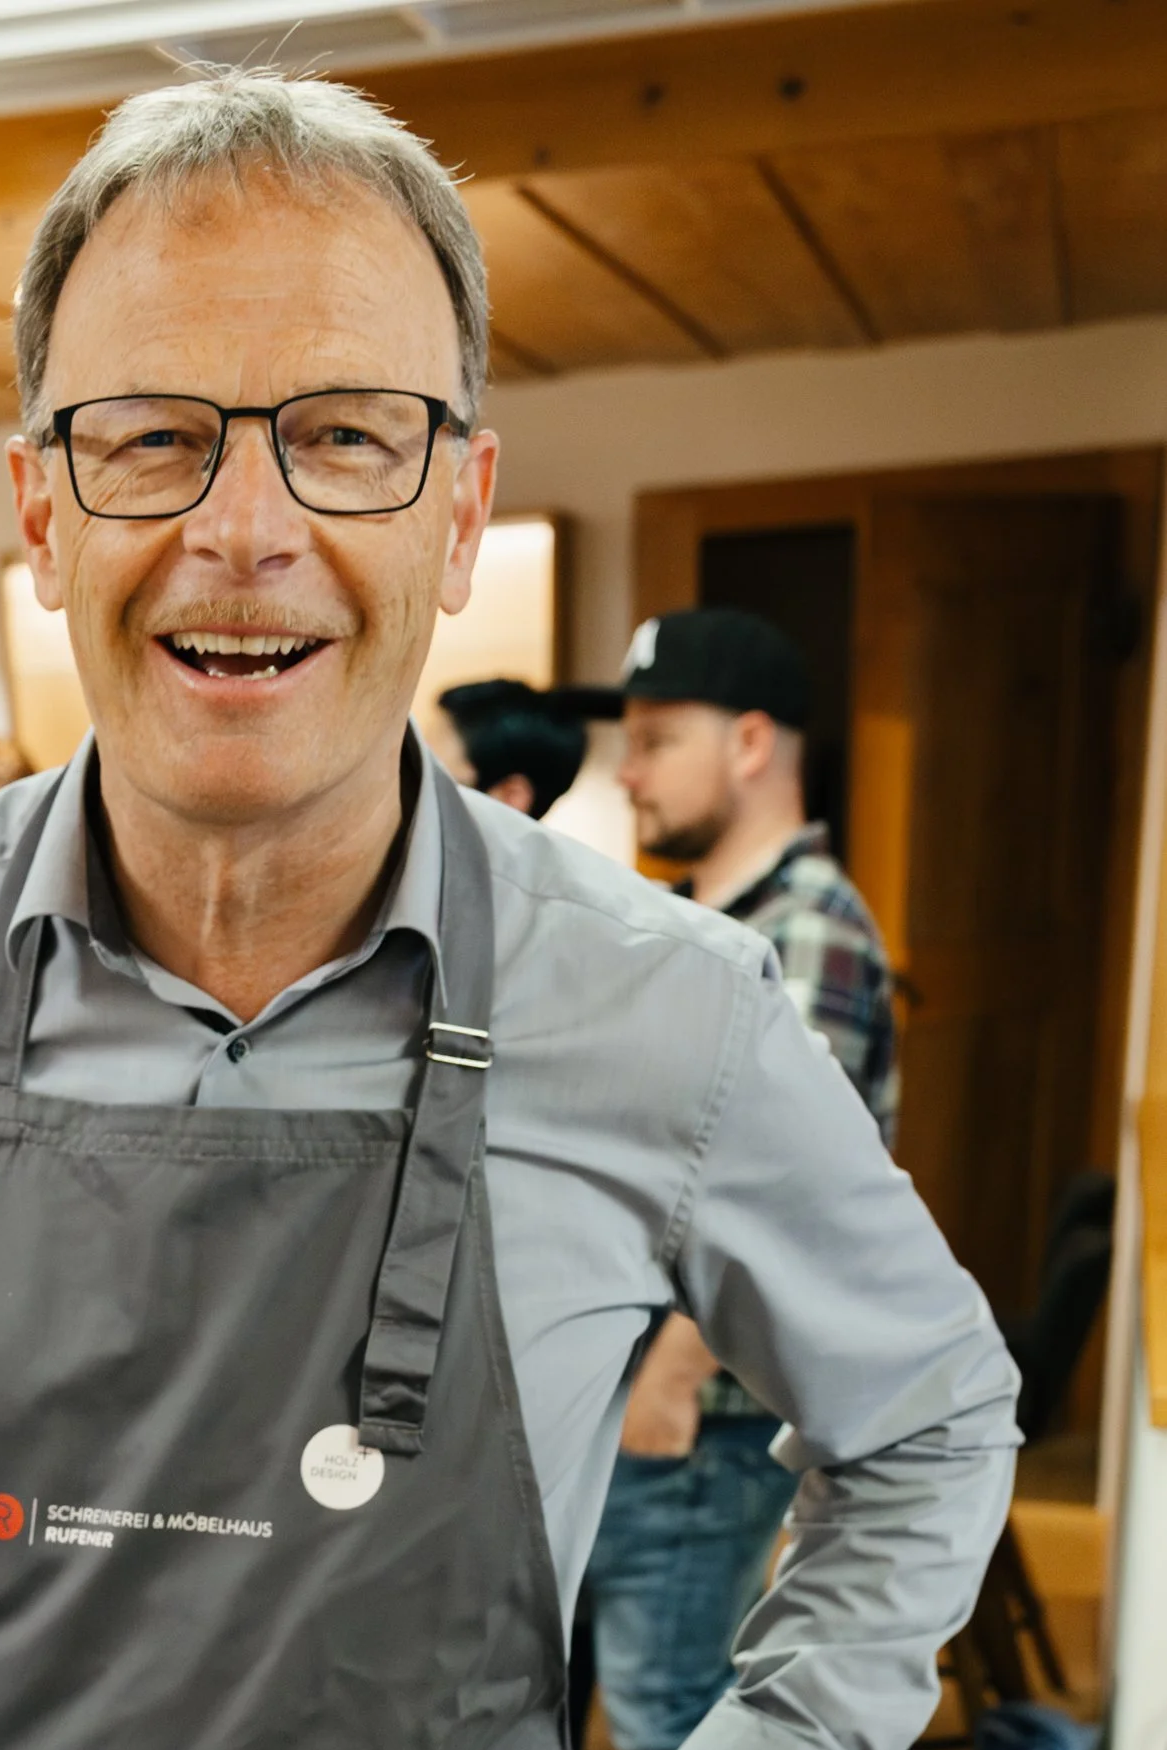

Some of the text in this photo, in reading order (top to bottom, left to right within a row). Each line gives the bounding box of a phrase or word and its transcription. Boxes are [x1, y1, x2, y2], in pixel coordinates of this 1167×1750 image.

[324, 1455, 359, 1468] HOLZ
[310, 1465, 359, 1481] DESIGN
[47, 1504, 273, 1538] SCHREINEREI & MÖBELHAUS
[44, 1525, 114, 1548] RUFENER
